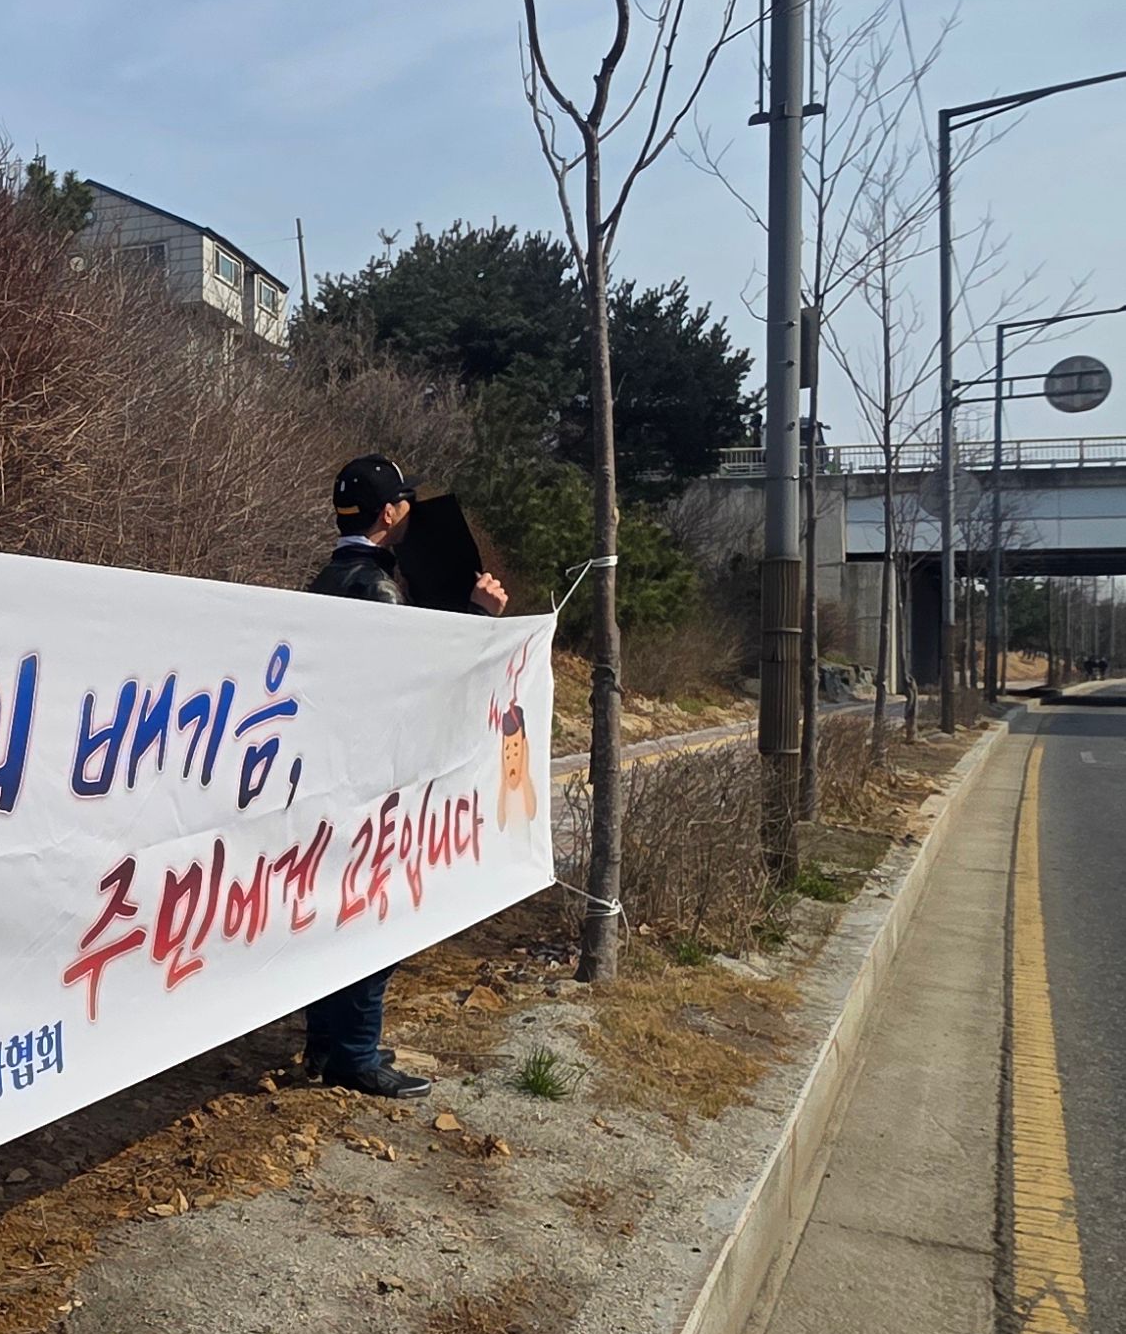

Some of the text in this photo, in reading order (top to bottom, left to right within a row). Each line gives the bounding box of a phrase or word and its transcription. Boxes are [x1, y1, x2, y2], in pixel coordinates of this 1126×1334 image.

[70, 642, 303, 811] 배기음,
[62, 779, 485, 1022] 주민에겐 고통입니다
